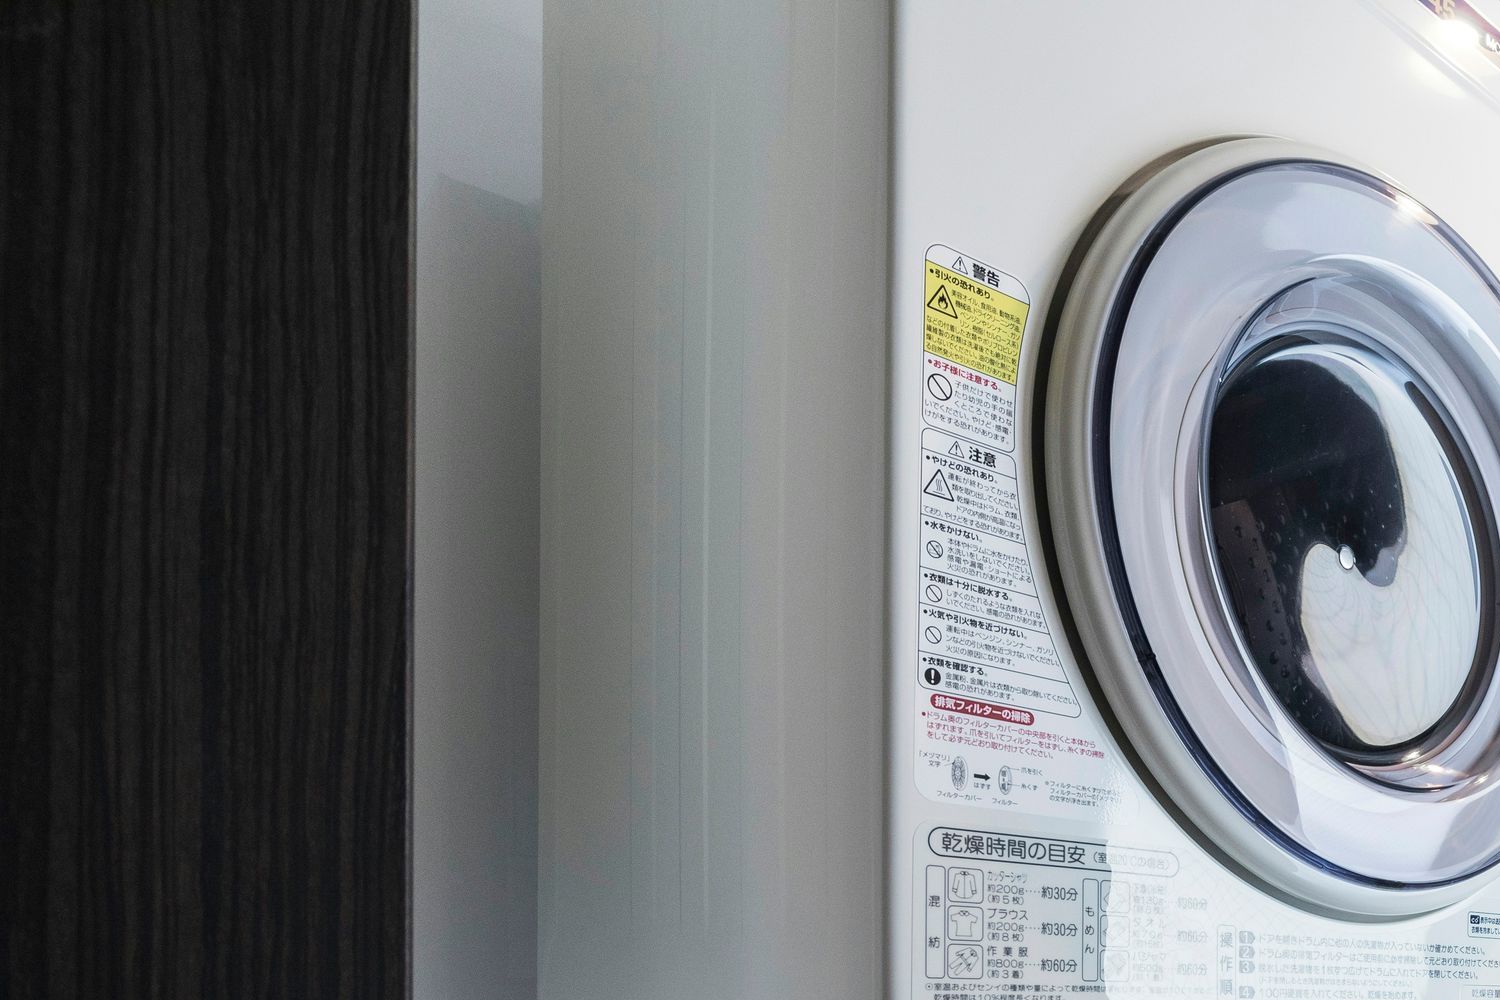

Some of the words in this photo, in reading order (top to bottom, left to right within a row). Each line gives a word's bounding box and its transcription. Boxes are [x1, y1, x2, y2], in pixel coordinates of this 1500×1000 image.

[934, 268, 994, 302] 引火の恐れあり。
[973, 263, 1000, 288] 警告
[933, 359, 1001, 392] お子様に注意する。
[969, 446, 996, 468] 注意
[932, 455, 997, 483] やけどの恐れあり。
[930, 520, 982, 543] 水をかけない。
[942, 833, 1085, 865] 乾燥時間の目安
[1041, 887, 1078, 901] 約30分
[988, 909, 1028, 920] ブラウス
[1041, 923, 1078, 936] 約30分
[1041, 959, 1077, 973] 約60分
